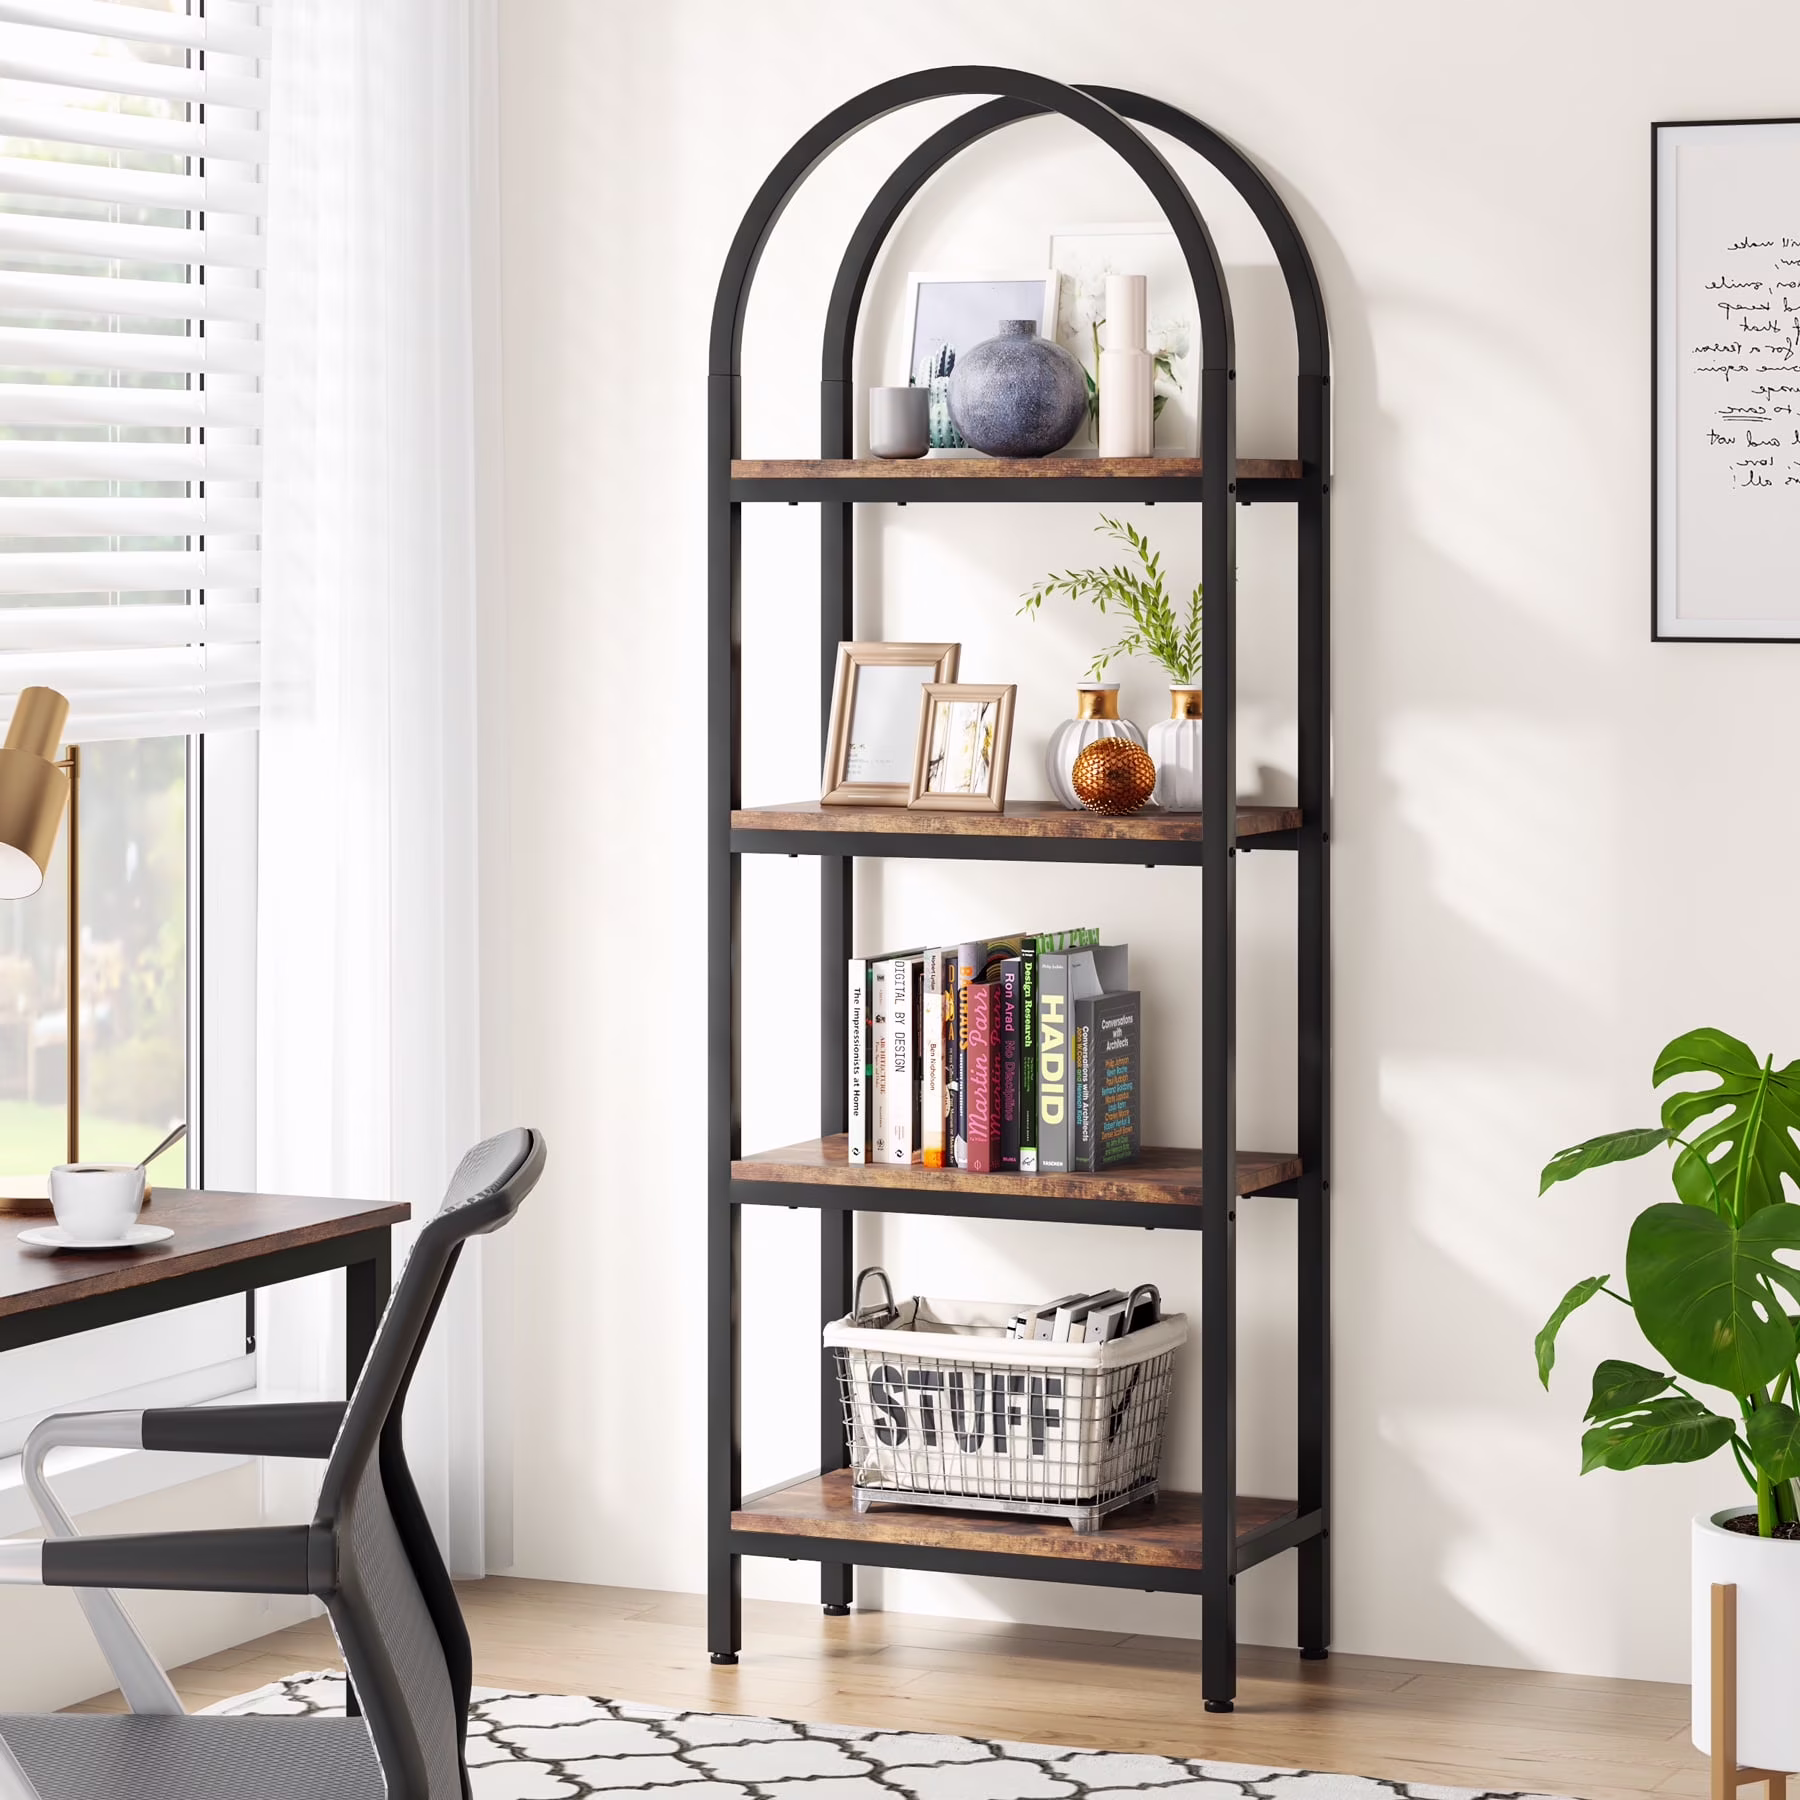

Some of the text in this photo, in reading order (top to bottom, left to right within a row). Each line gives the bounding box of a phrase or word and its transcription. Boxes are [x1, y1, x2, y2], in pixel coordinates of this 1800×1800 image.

[853, 987, 861, 1005] The
[1005, 973, 1015, 998] Ron
[1023, 962, 1033, 997] Design
[894, 961, 905, 1073] DIGITAL BY DESIGN
[968, 987, 988, 1047] Parr
[1005, 1002, 1015, 1032] Arad
[1024, 1000, 1033, 1047] Research
[1101, 1014, 1134, 1030] Conversations
[1112, 1027, 1123, 1038] with
[852, 1007, 861, 1075] Impressionists
[1005, 1040, 1015, 1059] No
[1106, 1037, 1129, 1051] Architects
[1041, 994, 1064, 1125] HADID
[853, 1078, 860, 1087] at
[968, 1053, 988, 1137] Martin
[1082, 1025, 1090, 1142] Conversations with Architects
[870, 1364, 1064, 1456] STUFF
